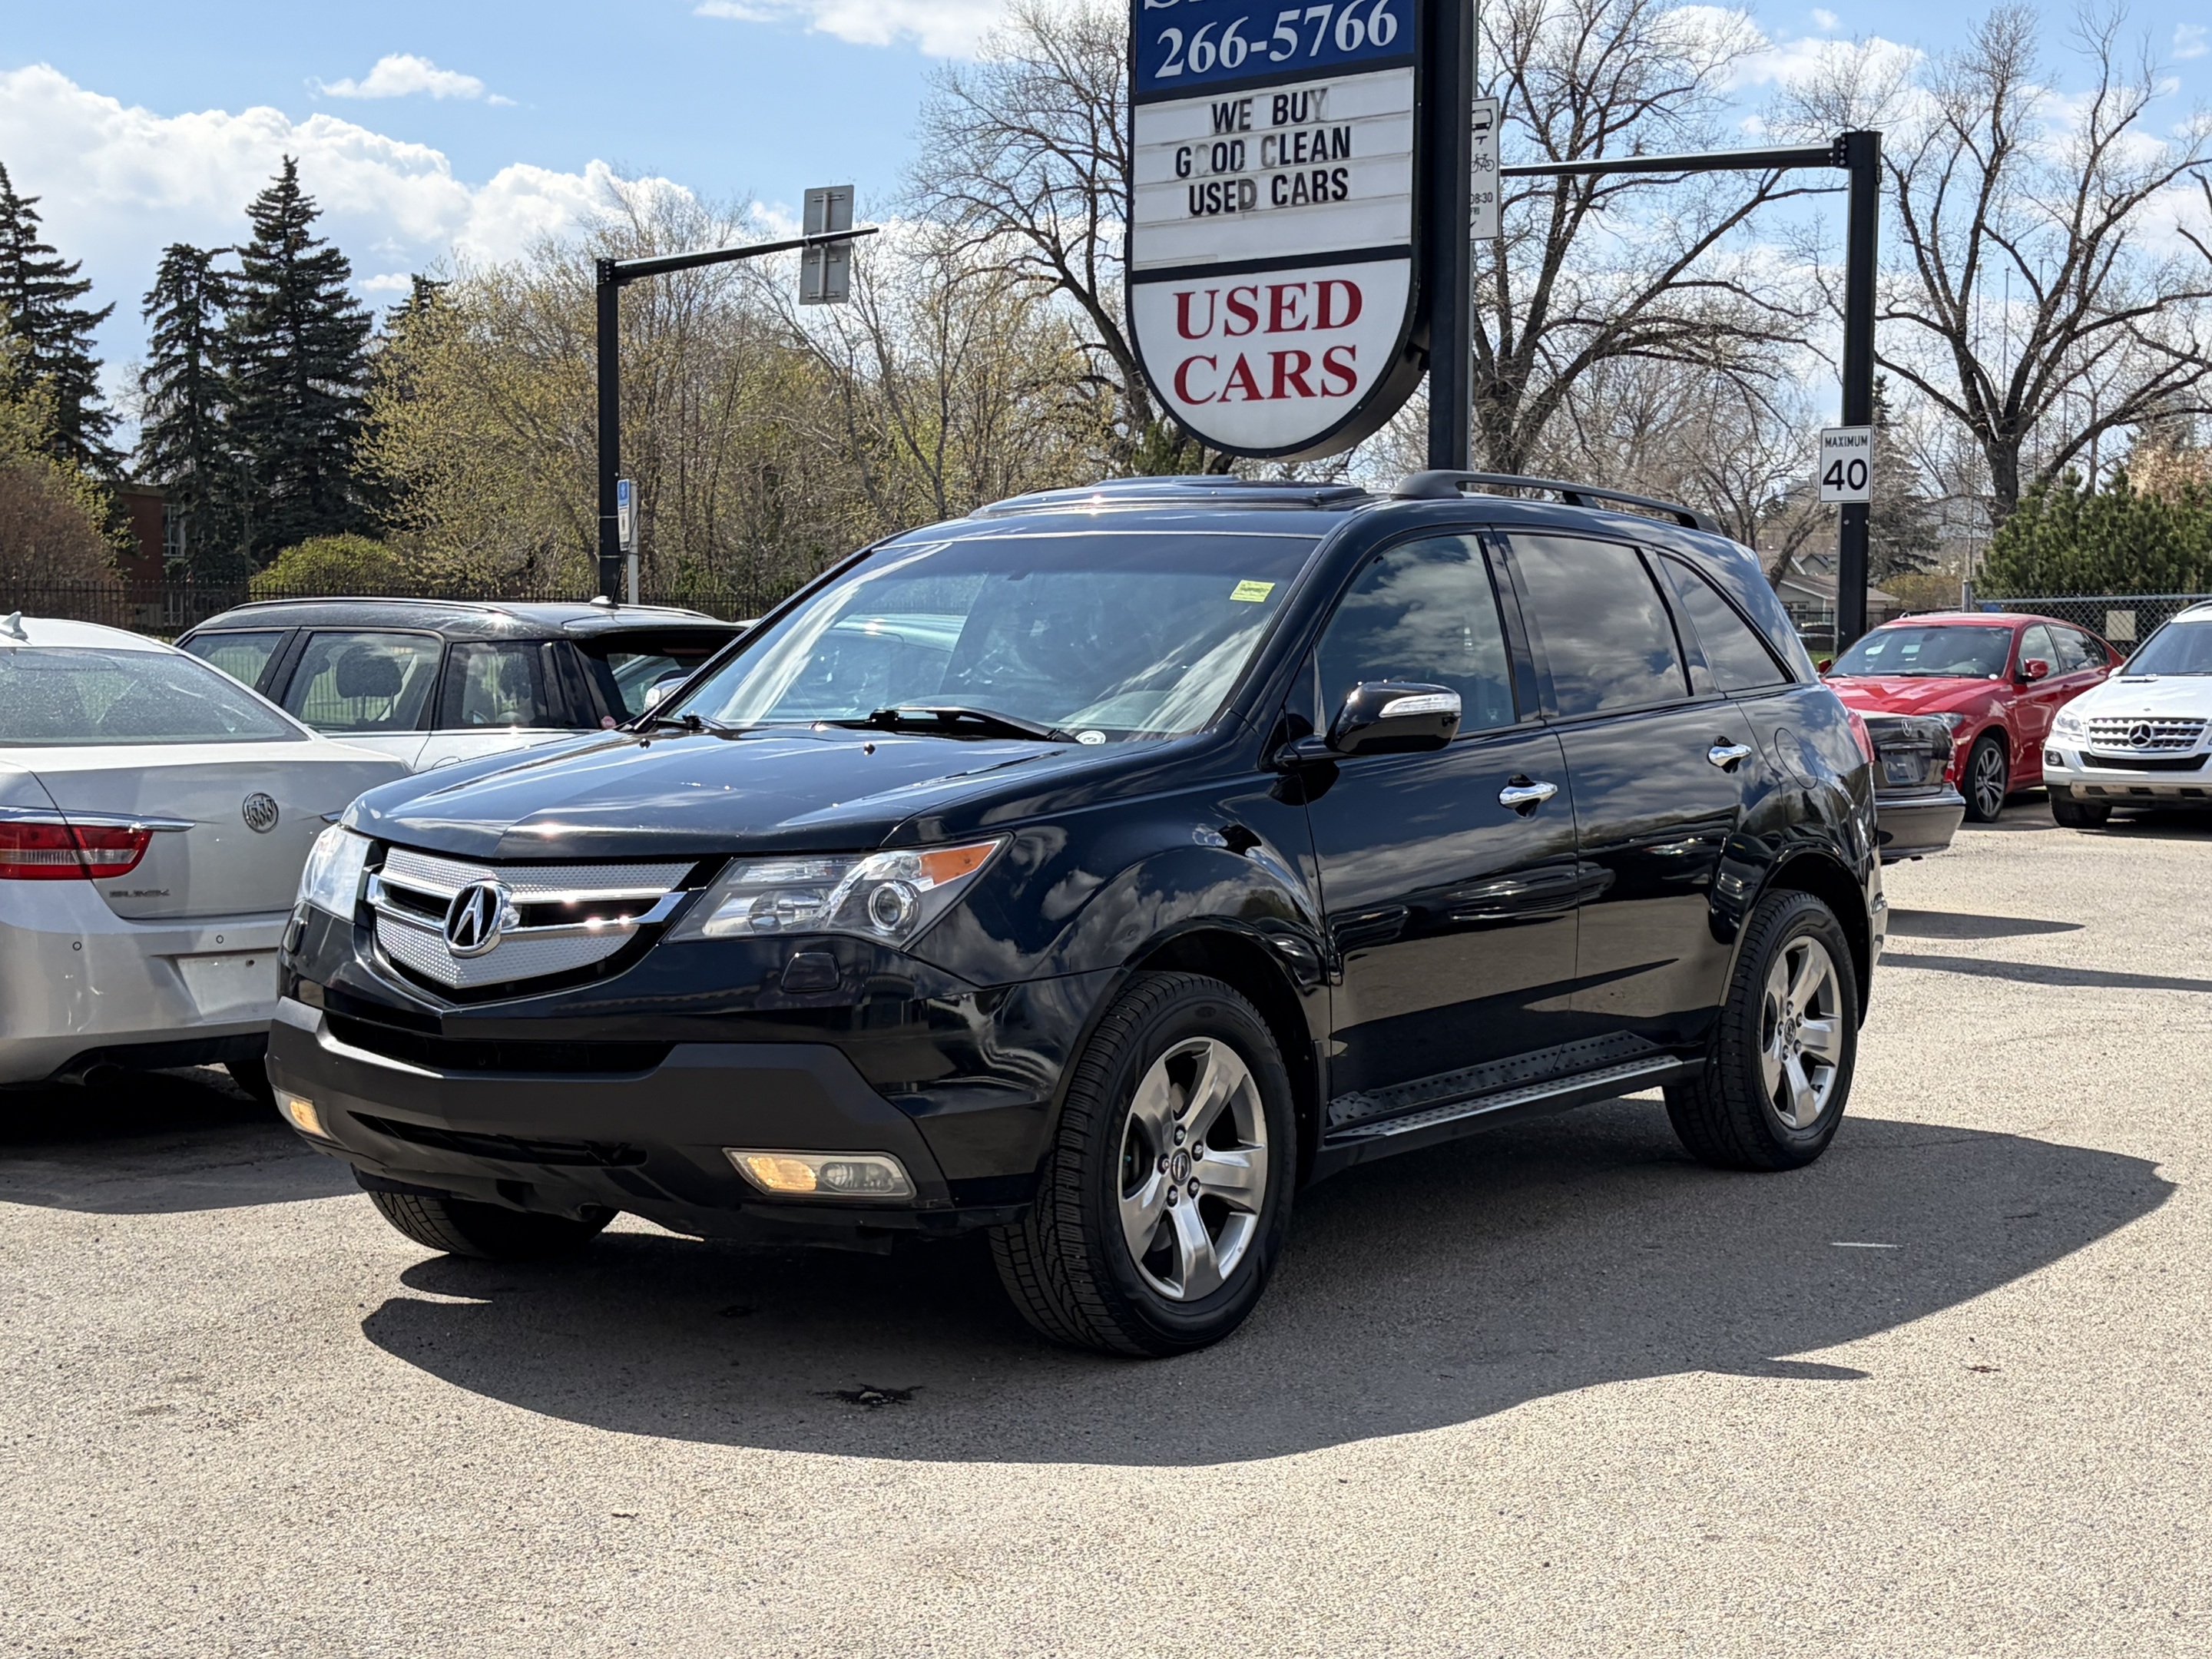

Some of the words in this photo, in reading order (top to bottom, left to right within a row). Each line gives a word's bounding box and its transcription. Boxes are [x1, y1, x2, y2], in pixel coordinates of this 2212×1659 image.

[1154, 0, 1398, 78] 266-5766
[1211, 98, 1253, 133] WE
[1272, 88, 1327, 126] BUY
[1176, 139, 1245, 178] GOOD
[1260, 125, 1350, 169] CLEAN
[1189, 178, 1257, 216] USED
[1271, 167, 1348, 206] CARS
[1172, 280, 1363, 339] USED
[1174, 344, 1357, 405] CARS
[1824, 435, 1868, 448] MAXIMUM
[1823, 459, 1868, 491] 40
